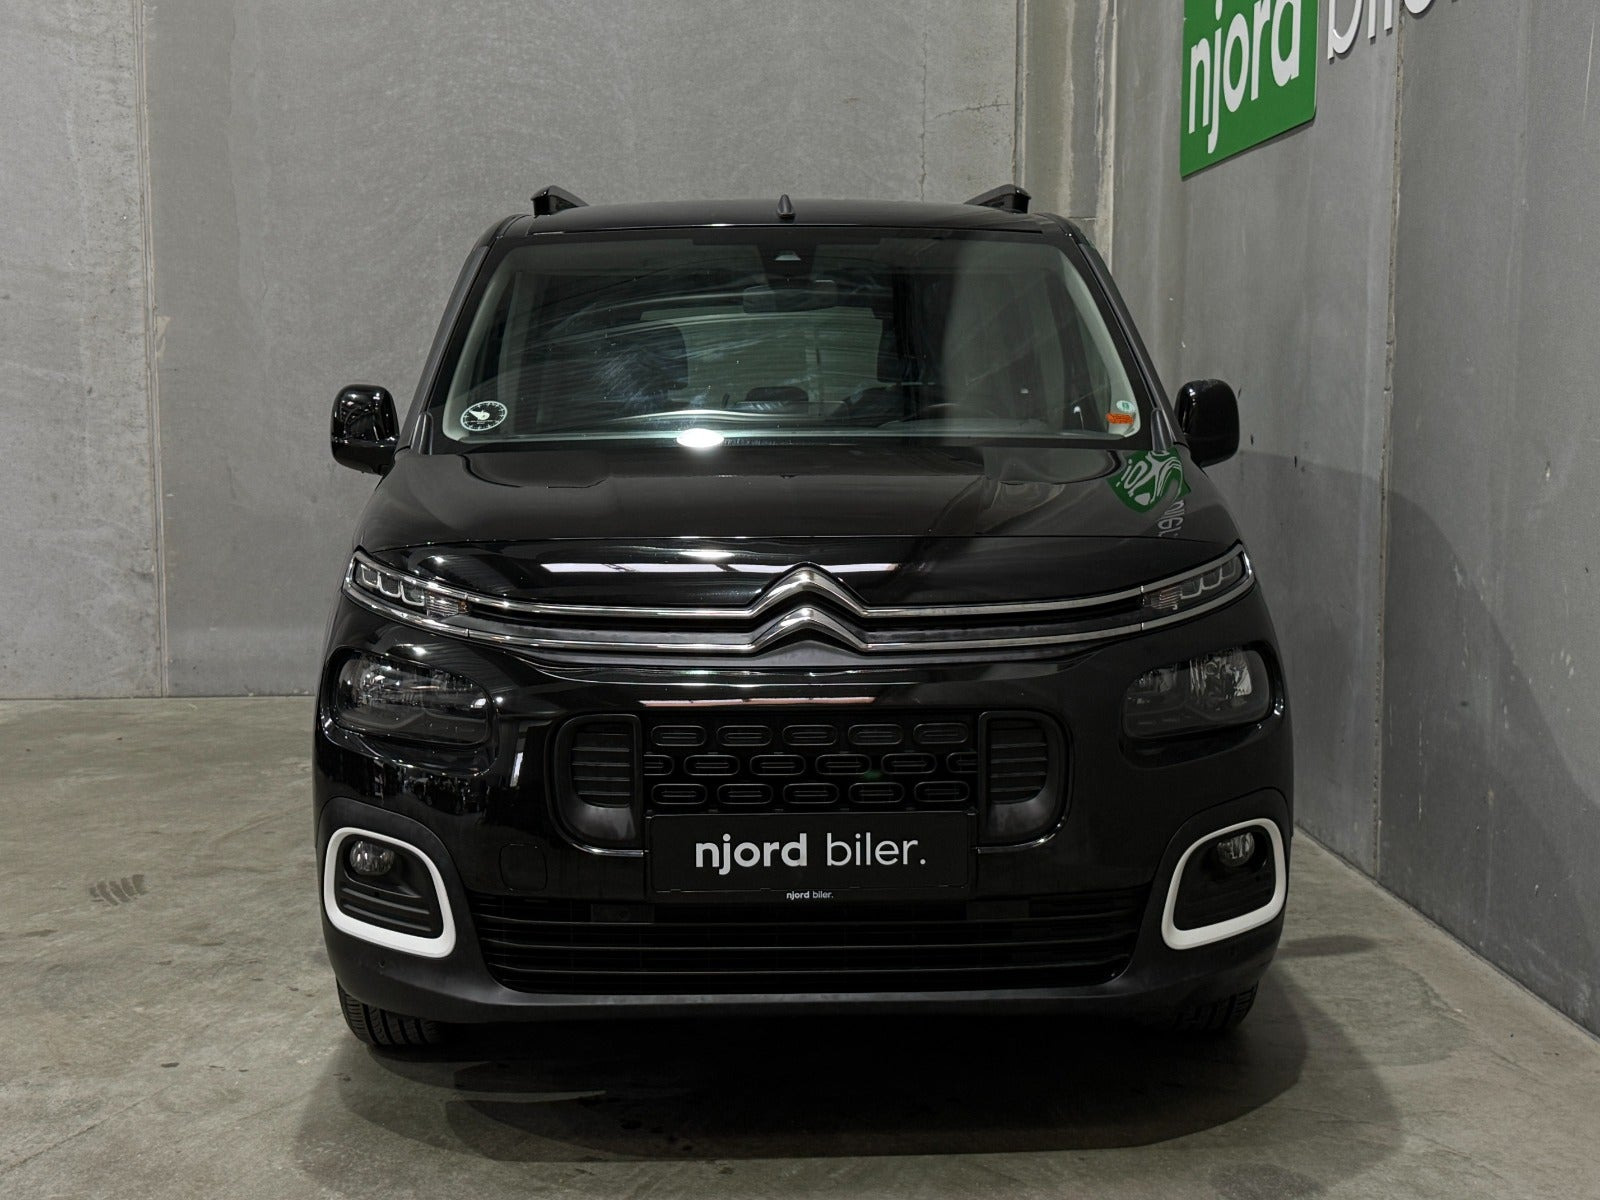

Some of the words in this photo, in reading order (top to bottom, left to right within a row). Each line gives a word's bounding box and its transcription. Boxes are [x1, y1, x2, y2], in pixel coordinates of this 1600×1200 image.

[1189, 0, 1301, 154] njord
[695, 832, 807, 876] njord
[826, 832, 926, 867] biler.
[786, 890, 810, 900] njord
[812, 890, 834, 899] biler.
